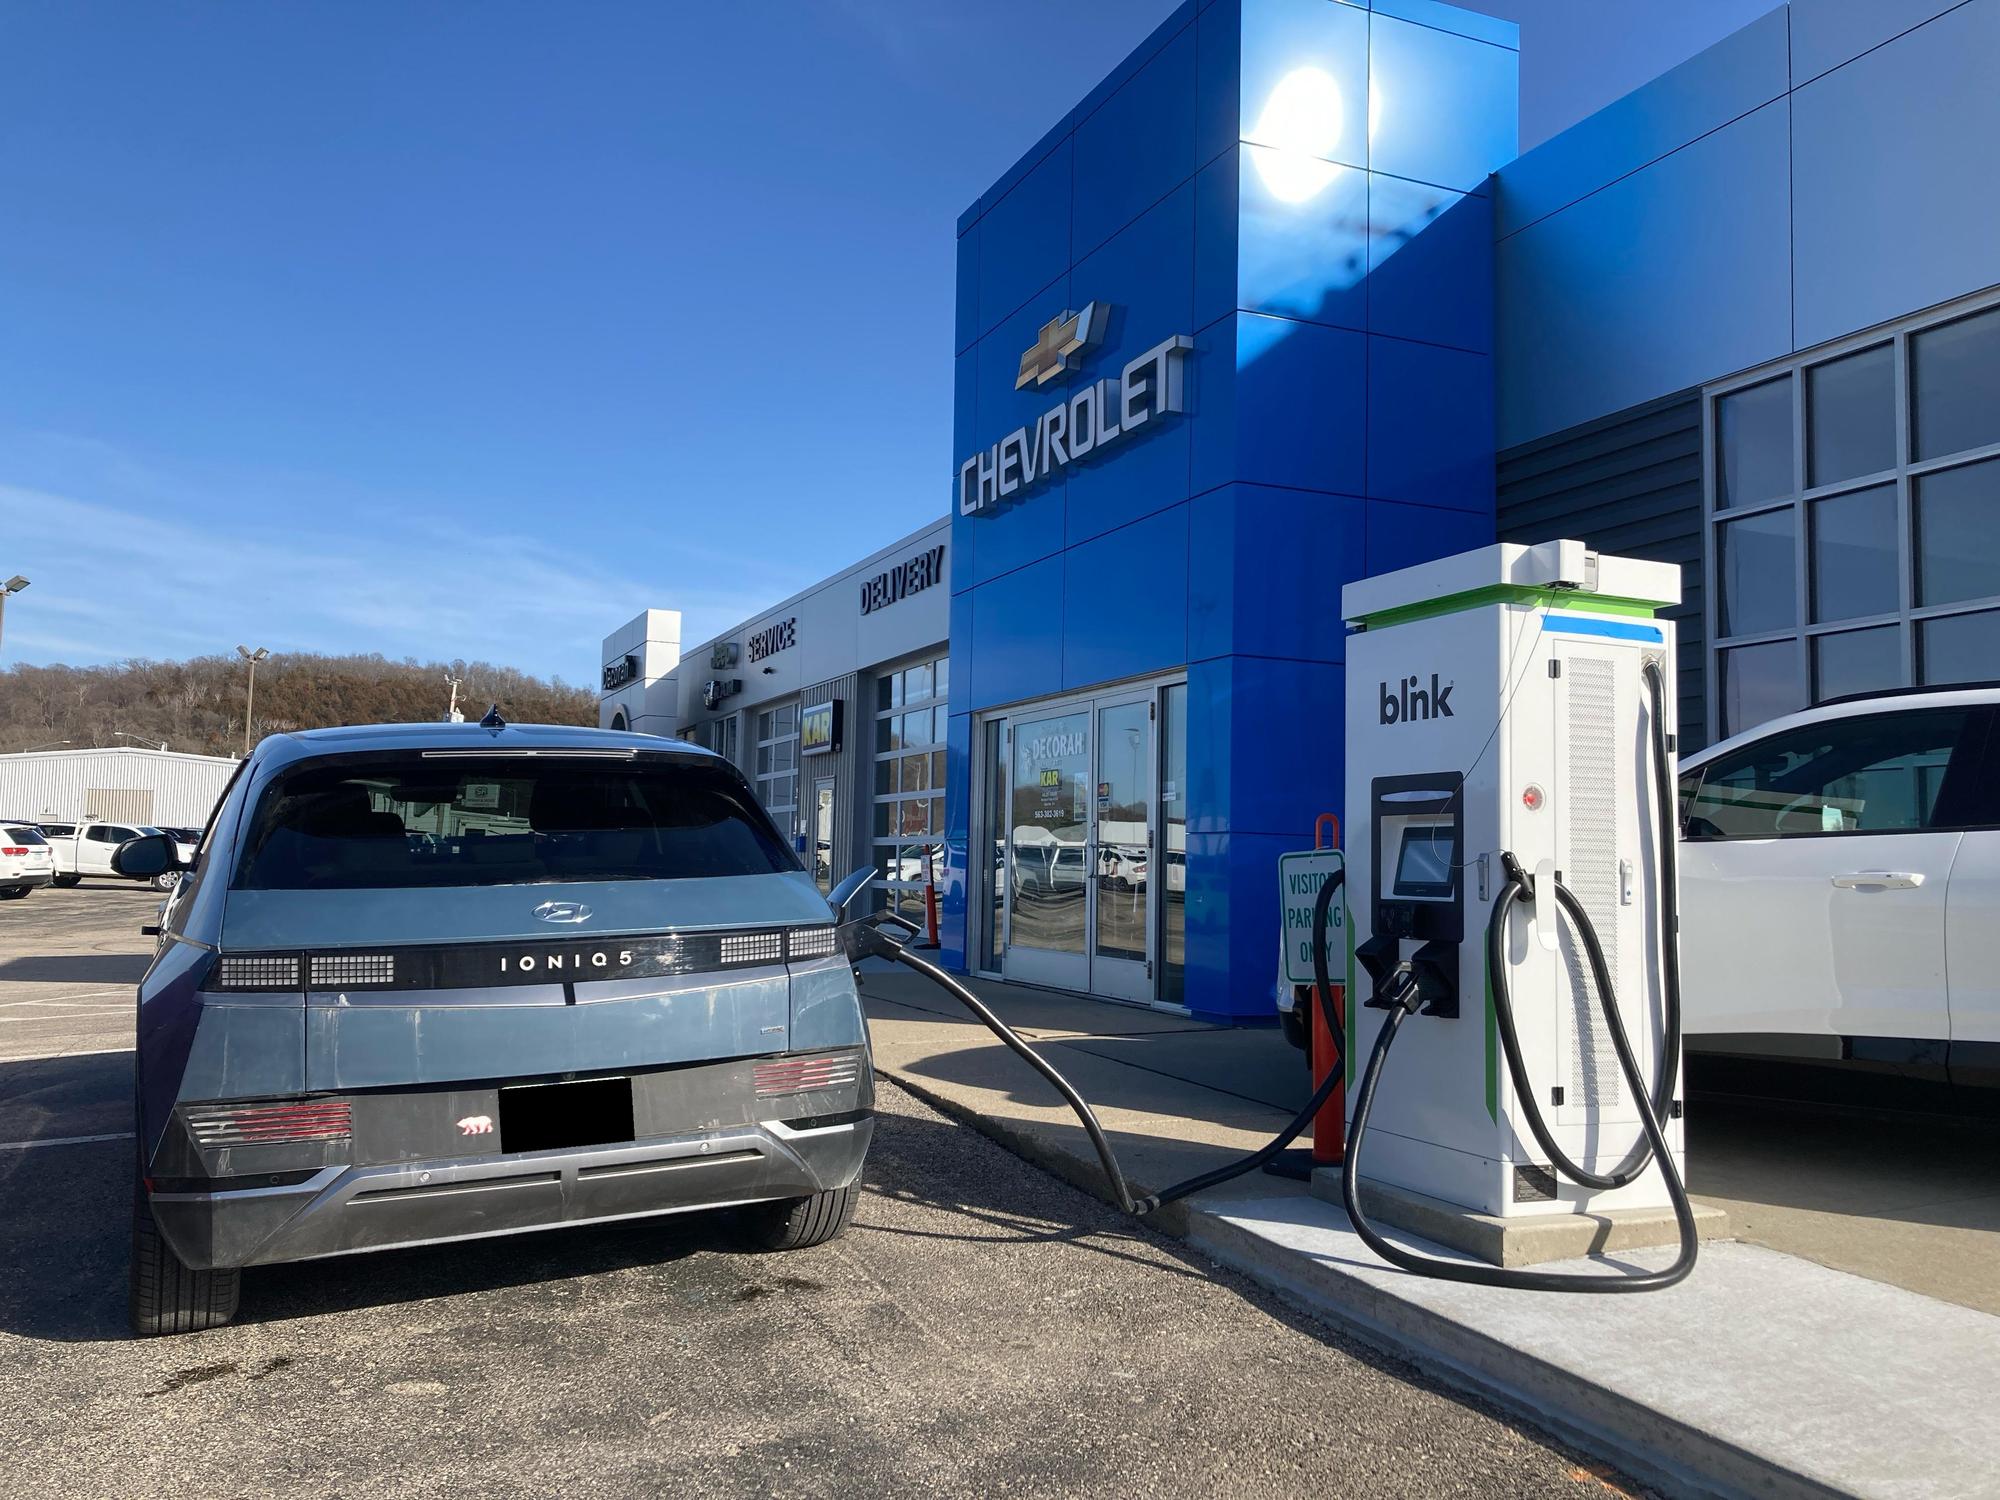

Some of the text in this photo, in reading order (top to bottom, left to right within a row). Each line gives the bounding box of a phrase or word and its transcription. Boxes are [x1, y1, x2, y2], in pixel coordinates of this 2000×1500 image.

[960, 335, 1191, 517] CHEVROLET
[860, 545, 945, 616] DELIVERY
[748, 617, 796, 663] SERVICE
[1380, 674, 1454, 725] blink
[802, 711, 830, 745] KAR
[1033, 733, 1083, 760] DECORAH
[1040, 770, 1059, 787] KAR
[1289, 872, 1334, 894] VISITO
[1288, 906, 1342, 928] PARNG
[1300, 941, 1332, 962] ONY
